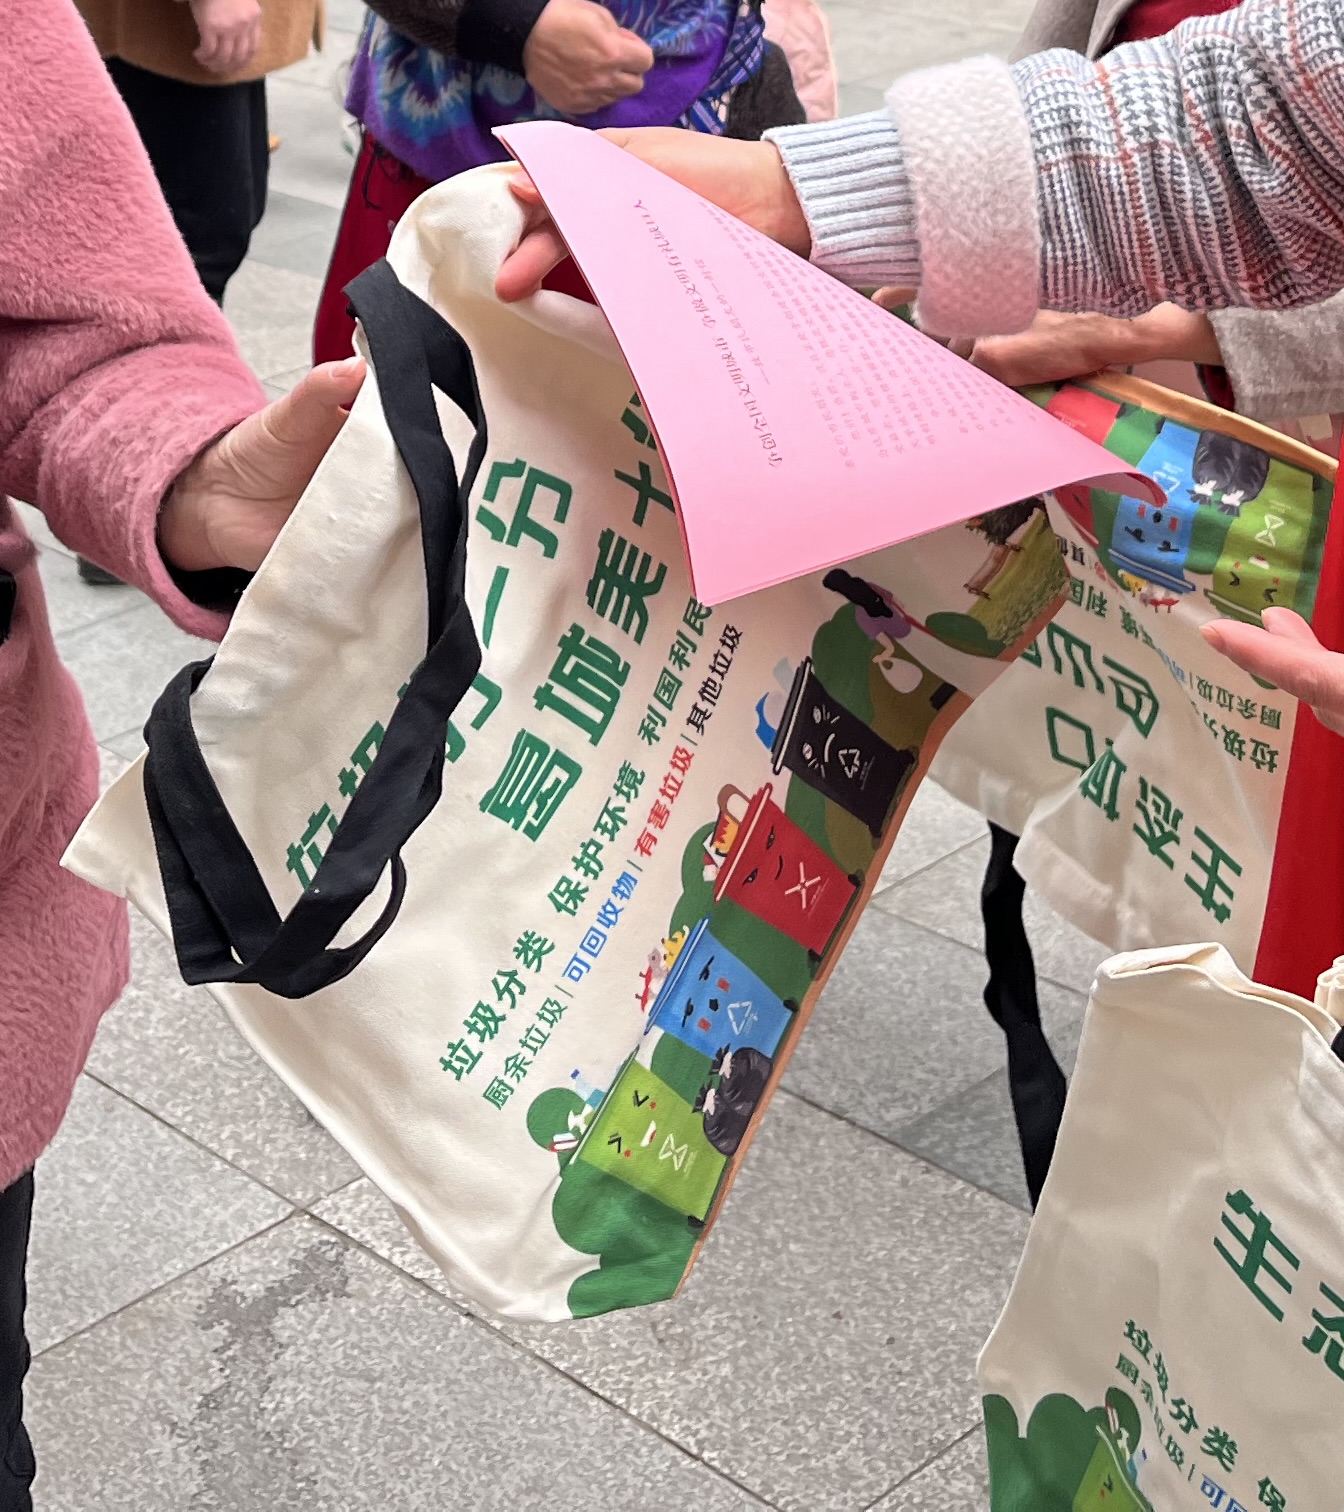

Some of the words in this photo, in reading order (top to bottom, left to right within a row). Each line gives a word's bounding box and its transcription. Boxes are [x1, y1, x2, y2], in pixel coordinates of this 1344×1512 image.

[439, 929, 556, 1082] 垃圾分类
[547, 760, 646, 917] 保护环境
[638, 595, 714, 747] 利国利民
[482, 996, 569, 1111] 厨余垃圾
[562, 872, 639, 984] 可回收物
[634, 744, 696, 858] 有害垃圾
[685, 623, 744, 735] 其他垃圾
[1122, 1319, 1239, 1474] 垃圾分类
